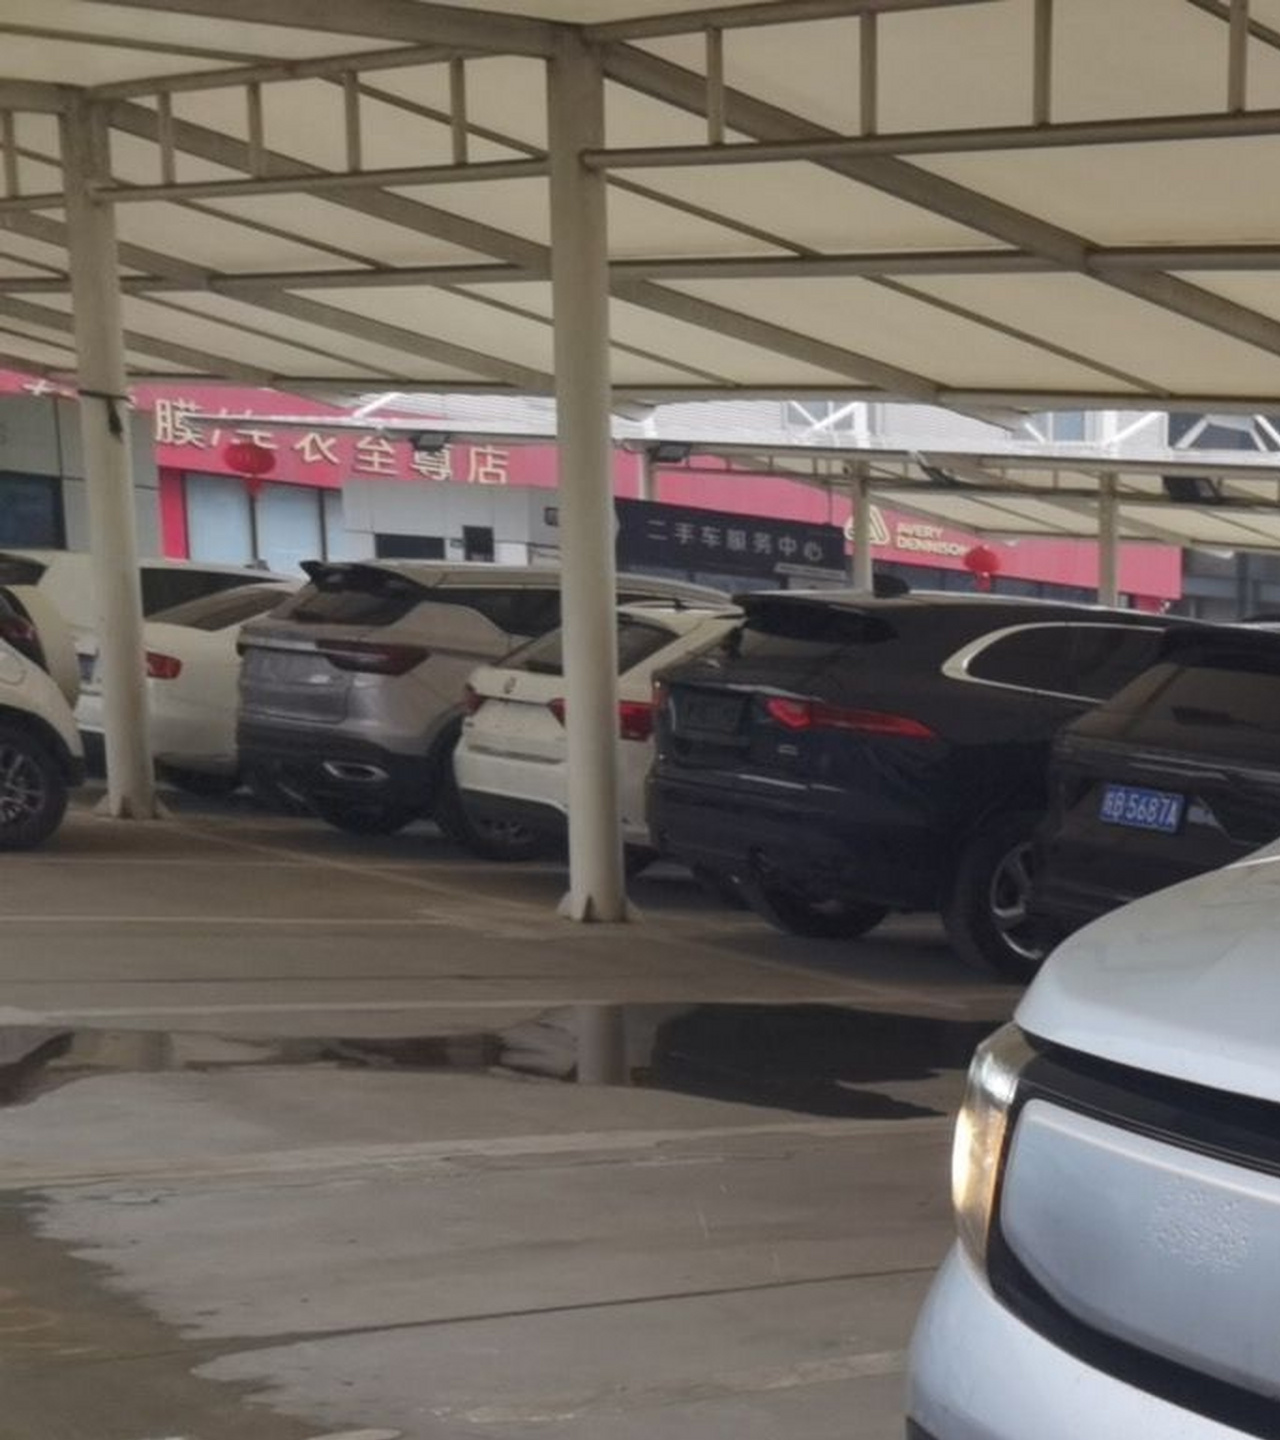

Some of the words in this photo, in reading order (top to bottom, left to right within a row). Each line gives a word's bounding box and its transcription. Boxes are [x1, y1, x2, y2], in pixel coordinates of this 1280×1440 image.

[646, 519, 823, 562] 二手车服务中心
